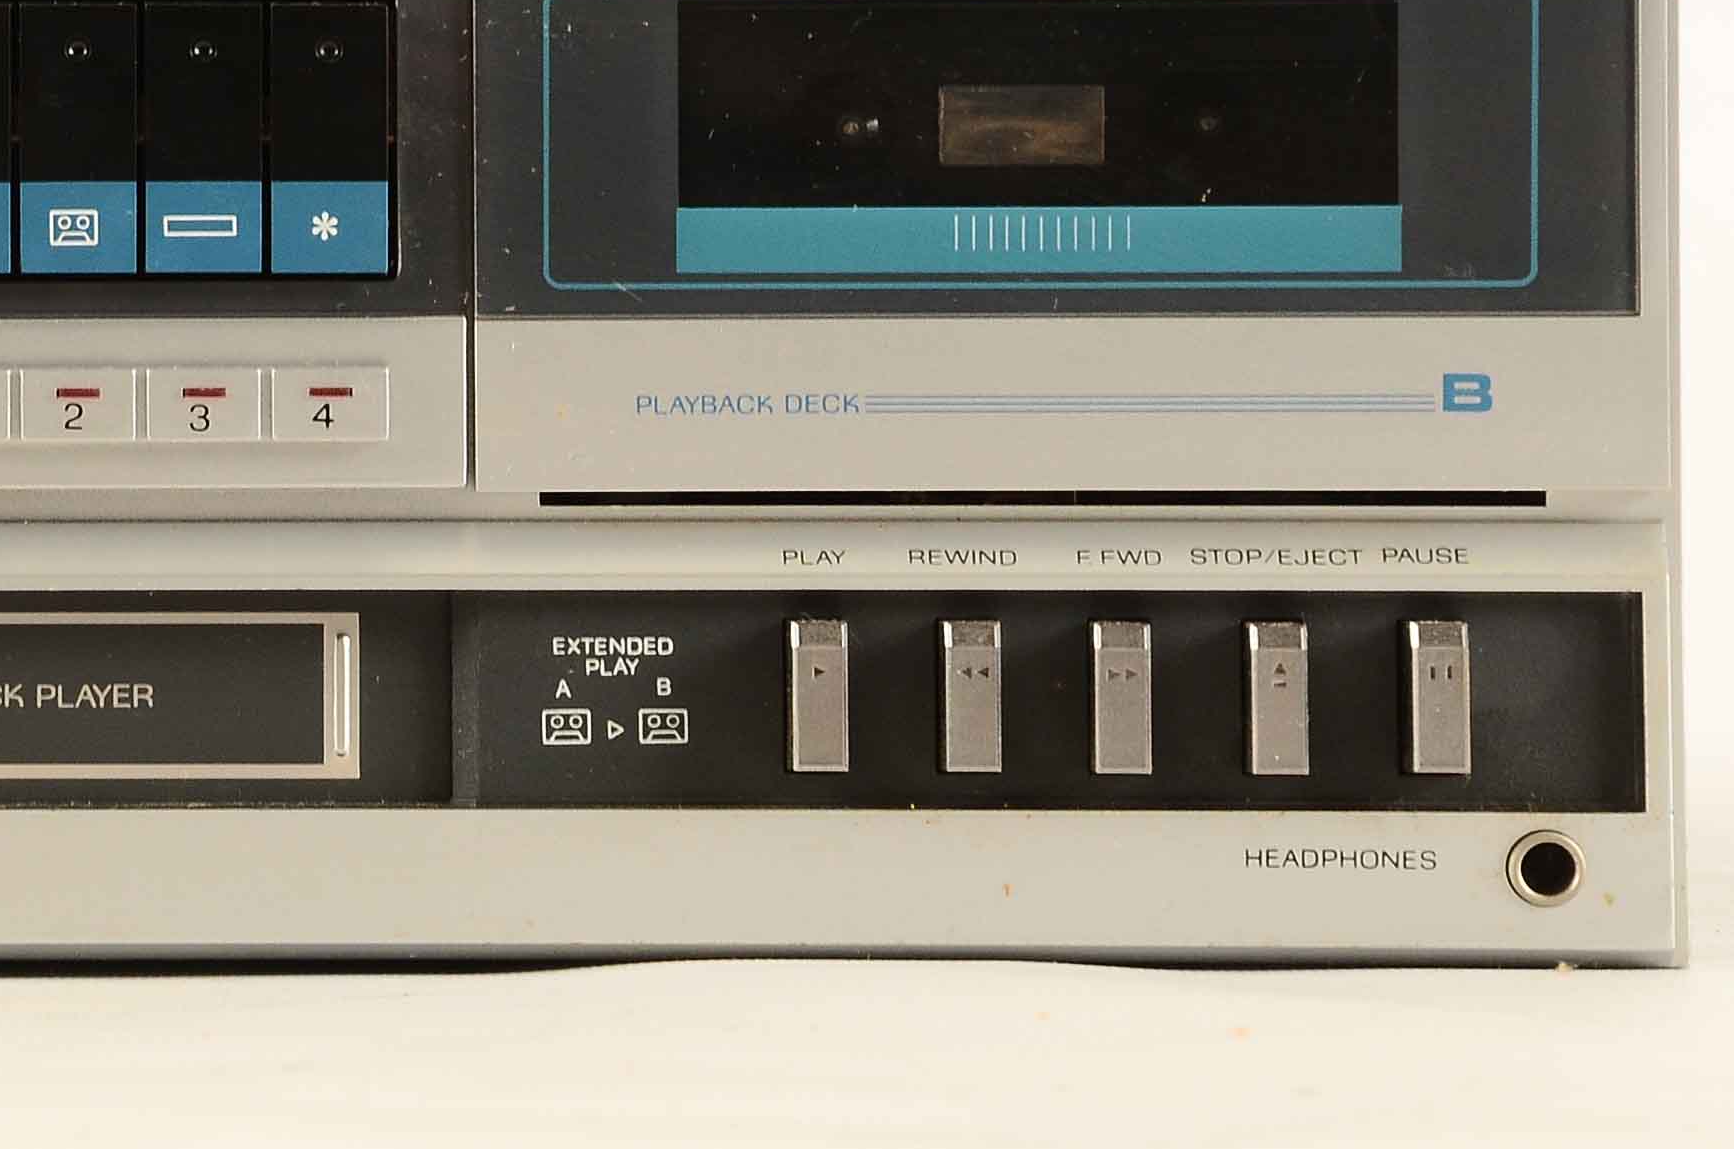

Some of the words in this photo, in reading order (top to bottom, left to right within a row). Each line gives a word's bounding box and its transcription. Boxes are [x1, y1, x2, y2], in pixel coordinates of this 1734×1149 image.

[1442, 372, 1493, 413] B
[636, 395, 773, 415] PLAYBACK
[785, 394, 860, 413] DECK
[64, 402, 83, 430] 2
[189, 404, 210, 432] 3
[312, 403, 334, 429] 4
[781, 550, 845, 565] PLAY
[908, 549, 1017, 565] REWIND
[1190, 548, 1363, 566] STOP/EJECT
[1382, 547, 1470, 565] PAUSE
[551, 636, 675, 656] EXTENDED
[584, 656, 640, 677] PLAY
[36, 683, 154, 709] PLAYER
[555, 678, 572, 699] A
[656, 676, 672, 696] B
[1245, 848, 1437, 870] HEADPHONES
